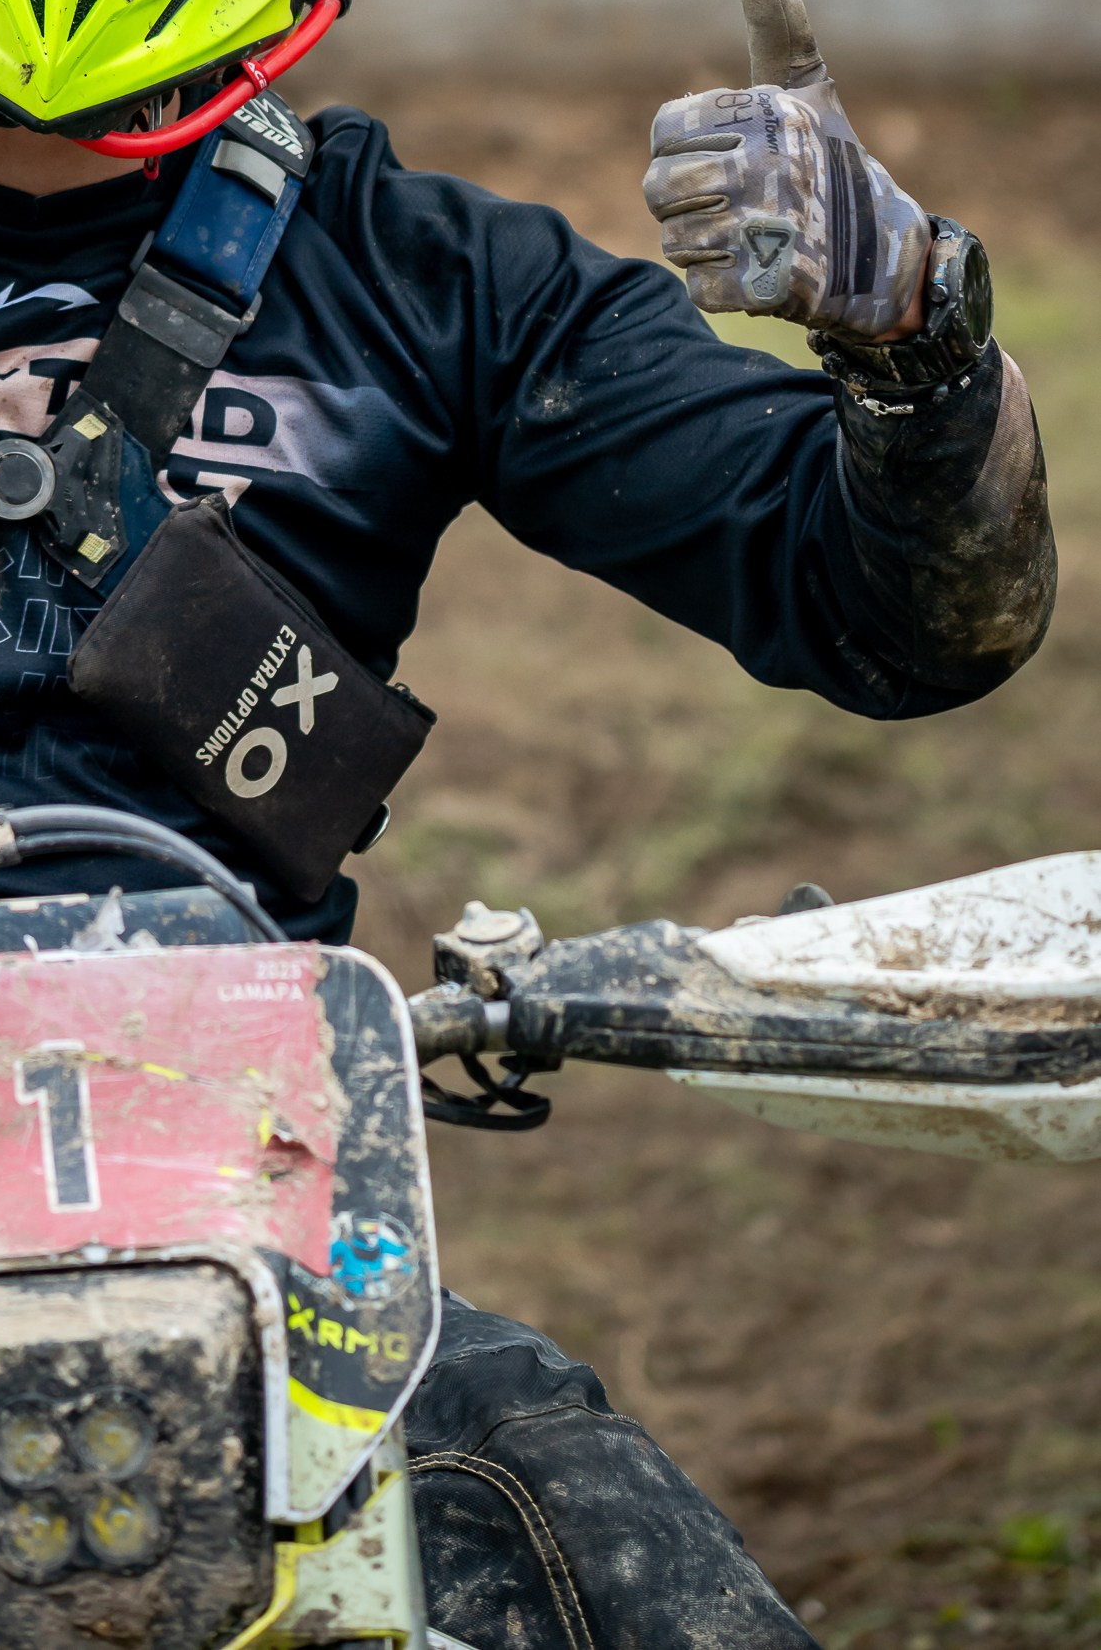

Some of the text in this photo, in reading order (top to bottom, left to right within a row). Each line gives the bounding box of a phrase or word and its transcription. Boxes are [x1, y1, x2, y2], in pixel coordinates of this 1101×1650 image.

[756, 92, 780, 154] Cape Town
[195, 624, 297, 766] EXTRA OPTIONS
[13, 1038, 102, 1213] 1
